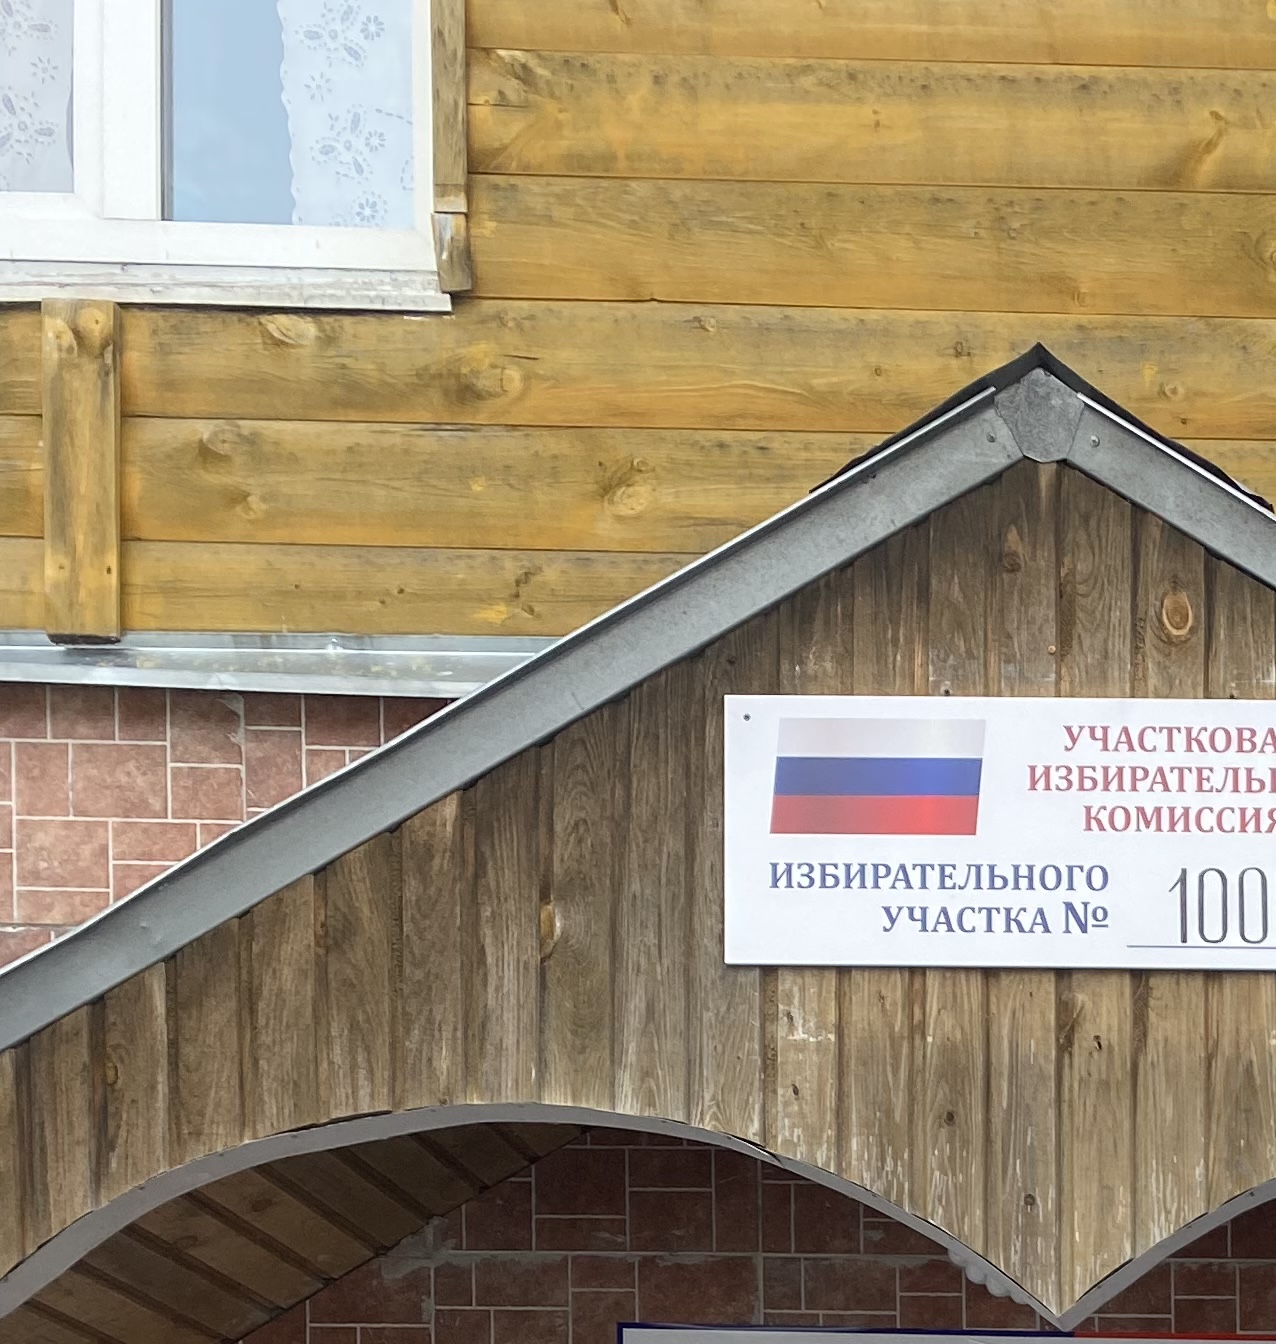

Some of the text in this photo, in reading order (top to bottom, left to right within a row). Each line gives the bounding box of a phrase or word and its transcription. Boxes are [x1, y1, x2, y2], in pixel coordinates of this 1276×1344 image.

[768, 862, 1110, 892] ИЗБИРАТЕЛЬНОГО
[881, 905, 1052, 934] УЧАСТКА
[1061, 901, 1110, 934] №
